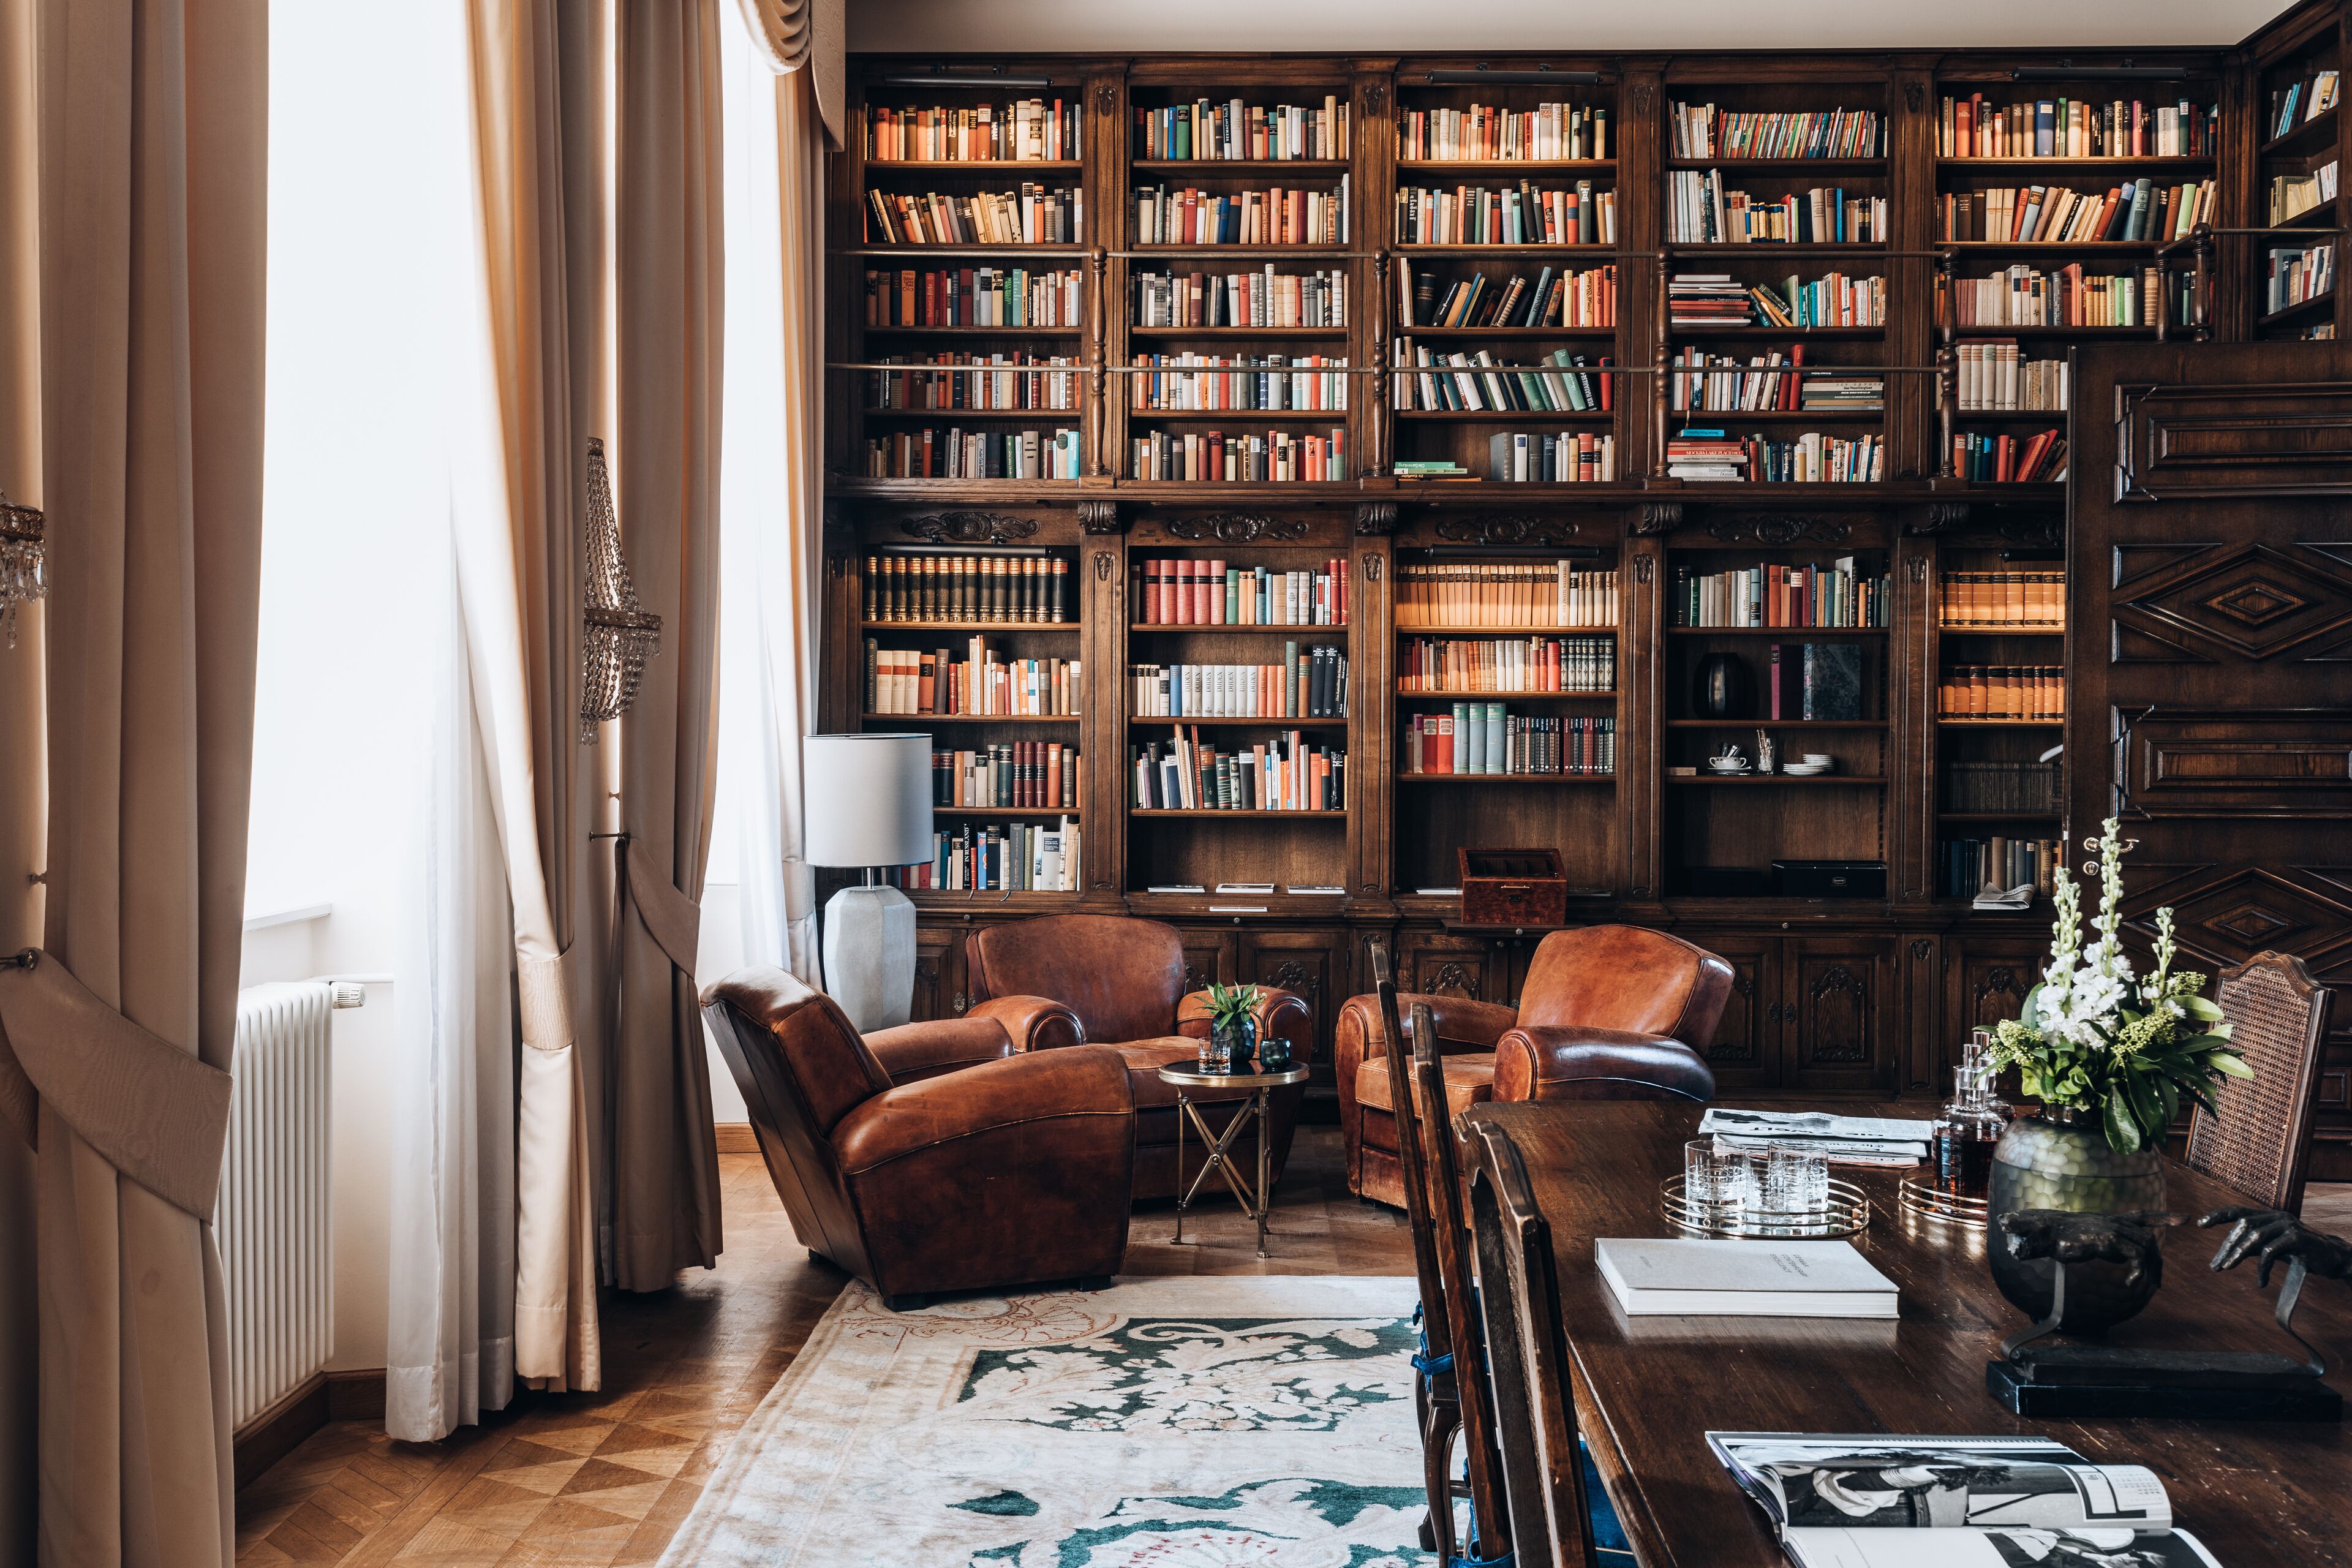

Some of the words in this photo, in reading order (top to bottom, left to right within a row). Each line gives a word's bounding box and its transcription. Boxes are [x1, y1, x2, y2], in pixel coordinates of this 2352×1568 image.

[1532, 287, 1545, 312] TRINAKRIA
[1770, 1254, 1792, 1273] EXCELLENCE
[1782, 1254, 1808, 1278] CONTEMPORARY
[1793, 1254, 1809, 1267] GERMAN
